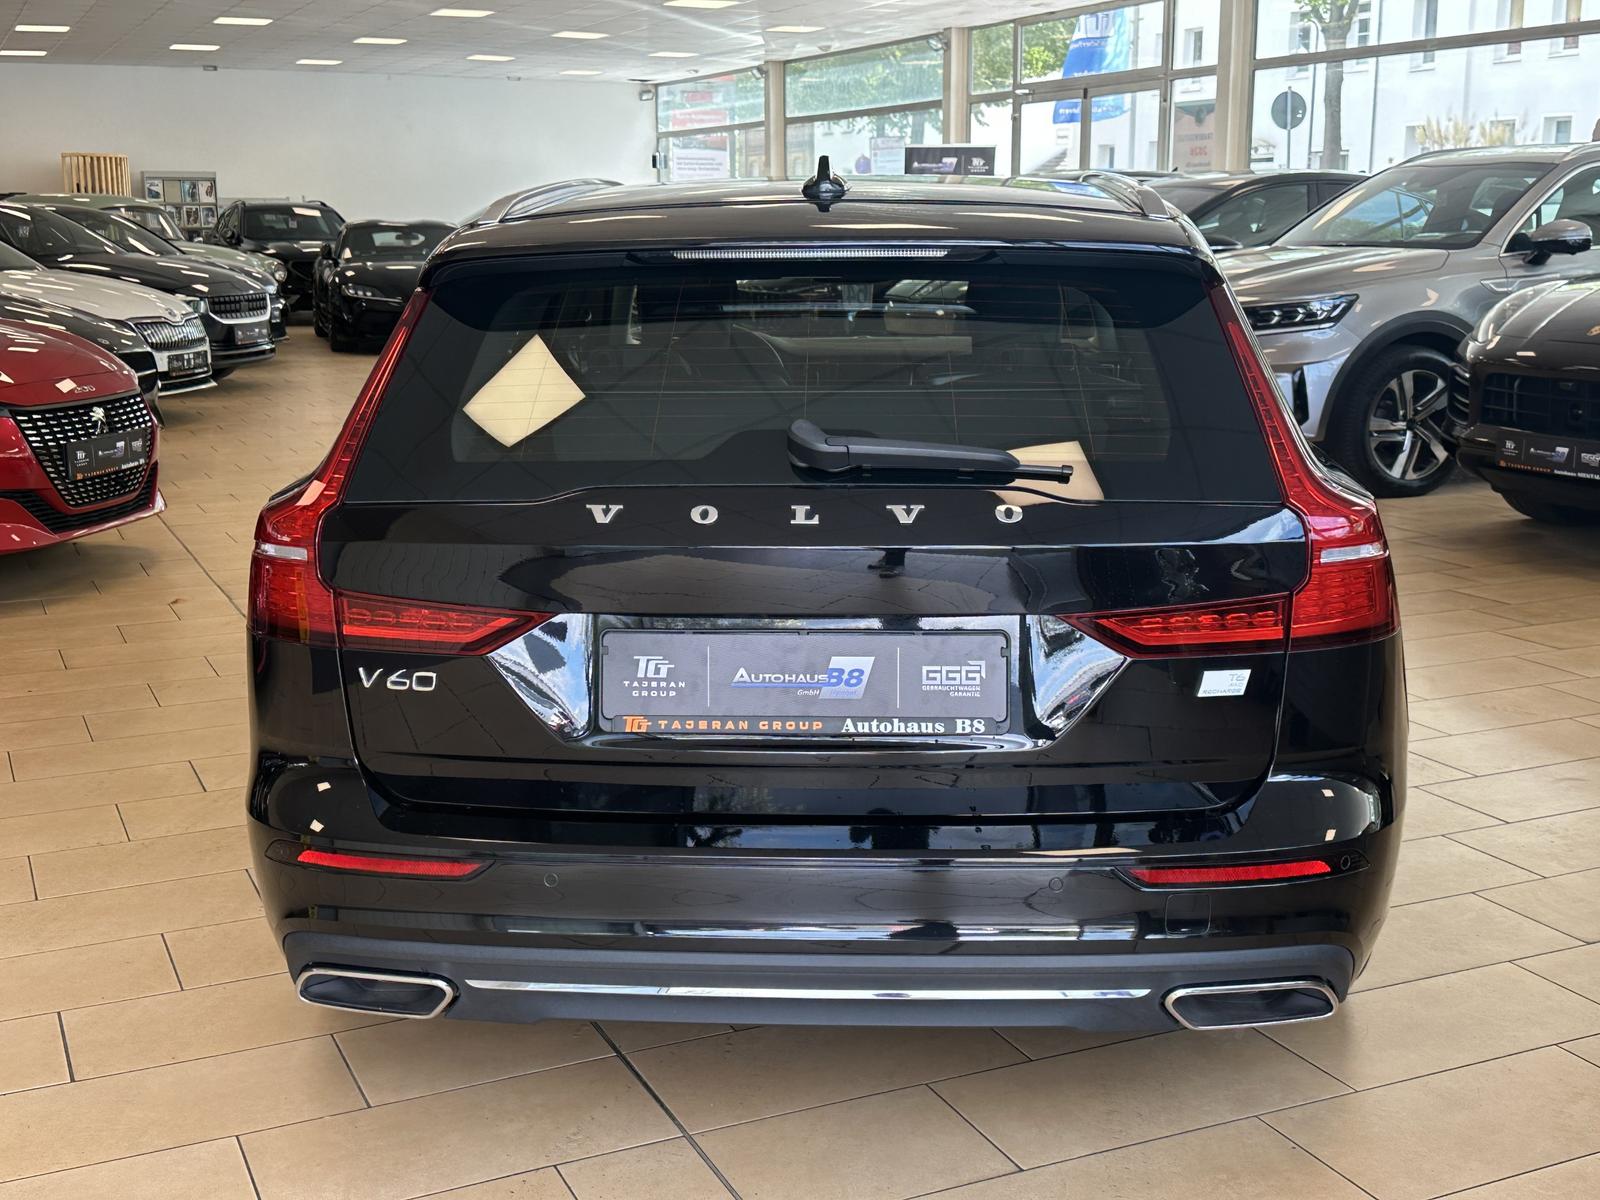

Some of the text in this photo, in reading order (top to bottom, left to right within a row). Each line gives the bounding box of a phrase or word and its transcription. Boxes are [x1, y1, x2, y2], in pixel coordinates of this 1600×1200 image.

[586, 504, 1024, 525] VOLVO
[358, 667, 437, 691] V60
[623, 680, 686, 688] TAJERAN
[797, 688, 820, 696] GmbH
[658, 720, 749, 730] TAJERAN
[759, 720, 823, 730] GROUP
[841, 718, 986, 734] Autohaus B8
